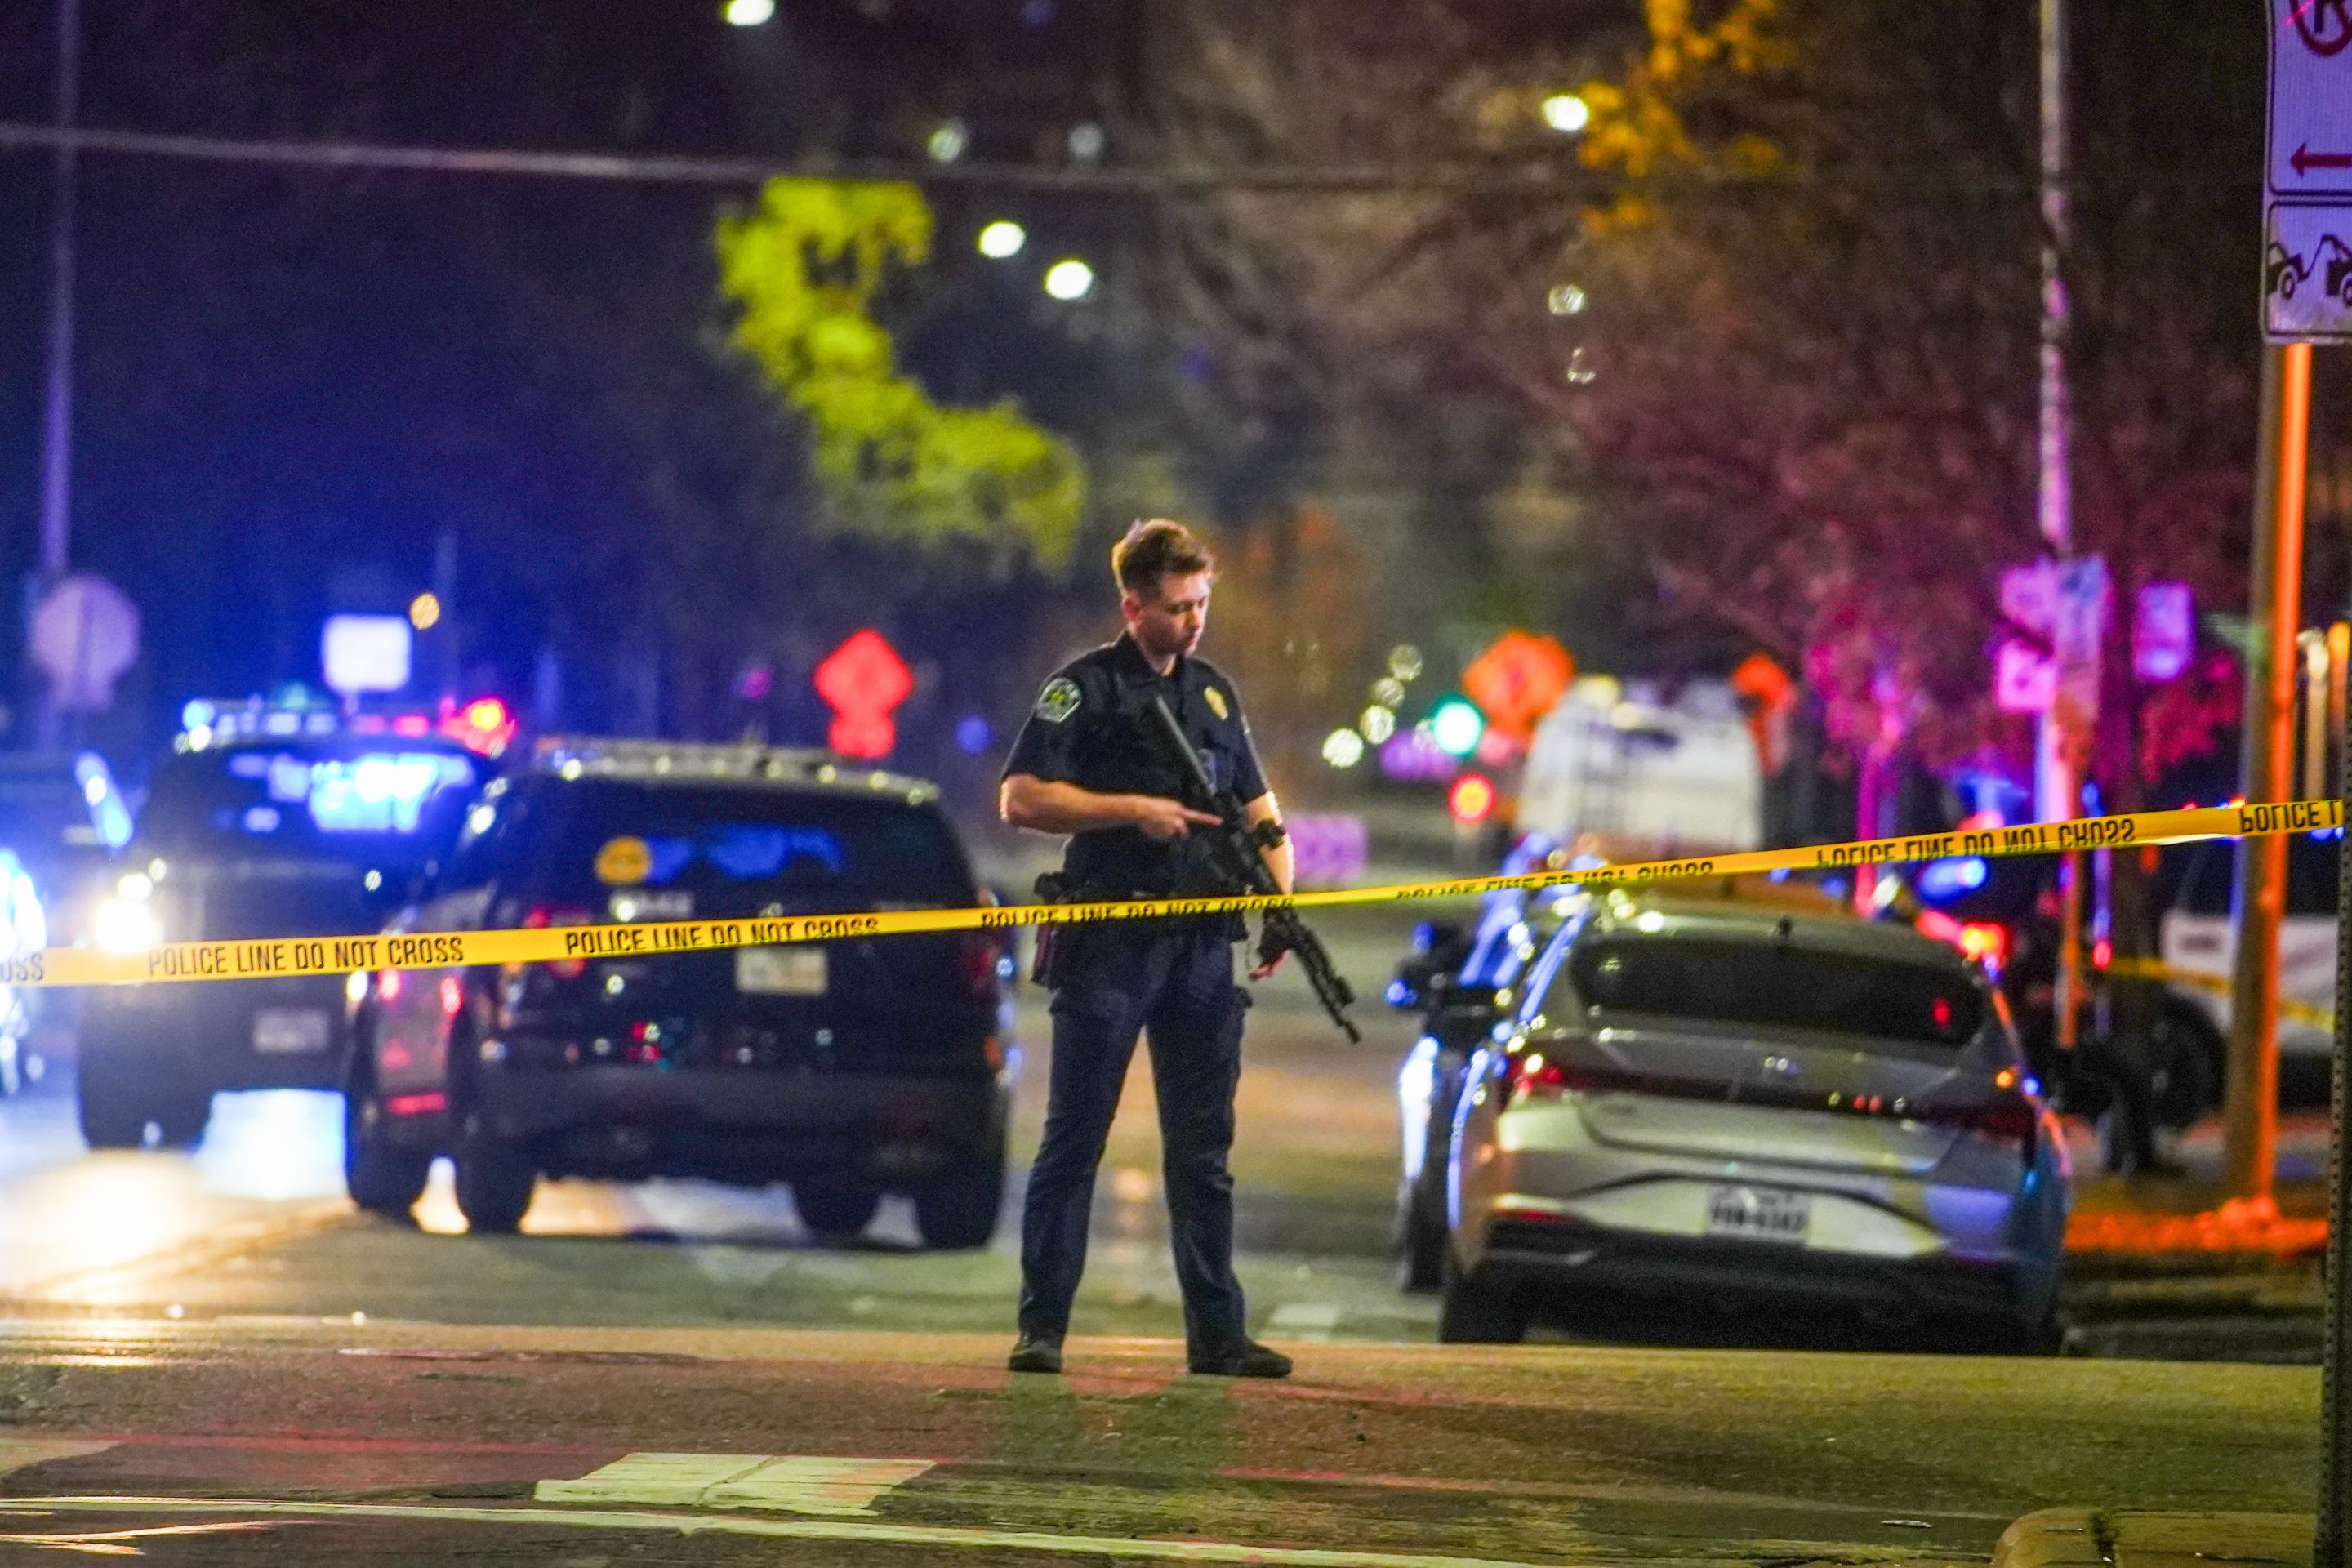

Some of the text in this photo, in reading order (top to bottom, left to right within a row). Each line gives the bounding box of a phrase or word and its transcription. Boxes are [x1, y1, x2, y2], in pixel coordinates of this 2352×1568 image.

[147, 935, 465, 978] POLICE LINE DO NOT CROSS
[565, 928, 648, 956] POLICE
[653, 926, 705, 949] LINE
[711, 924, 742, 946] DO
[751, 921, 795, 942] NOT
